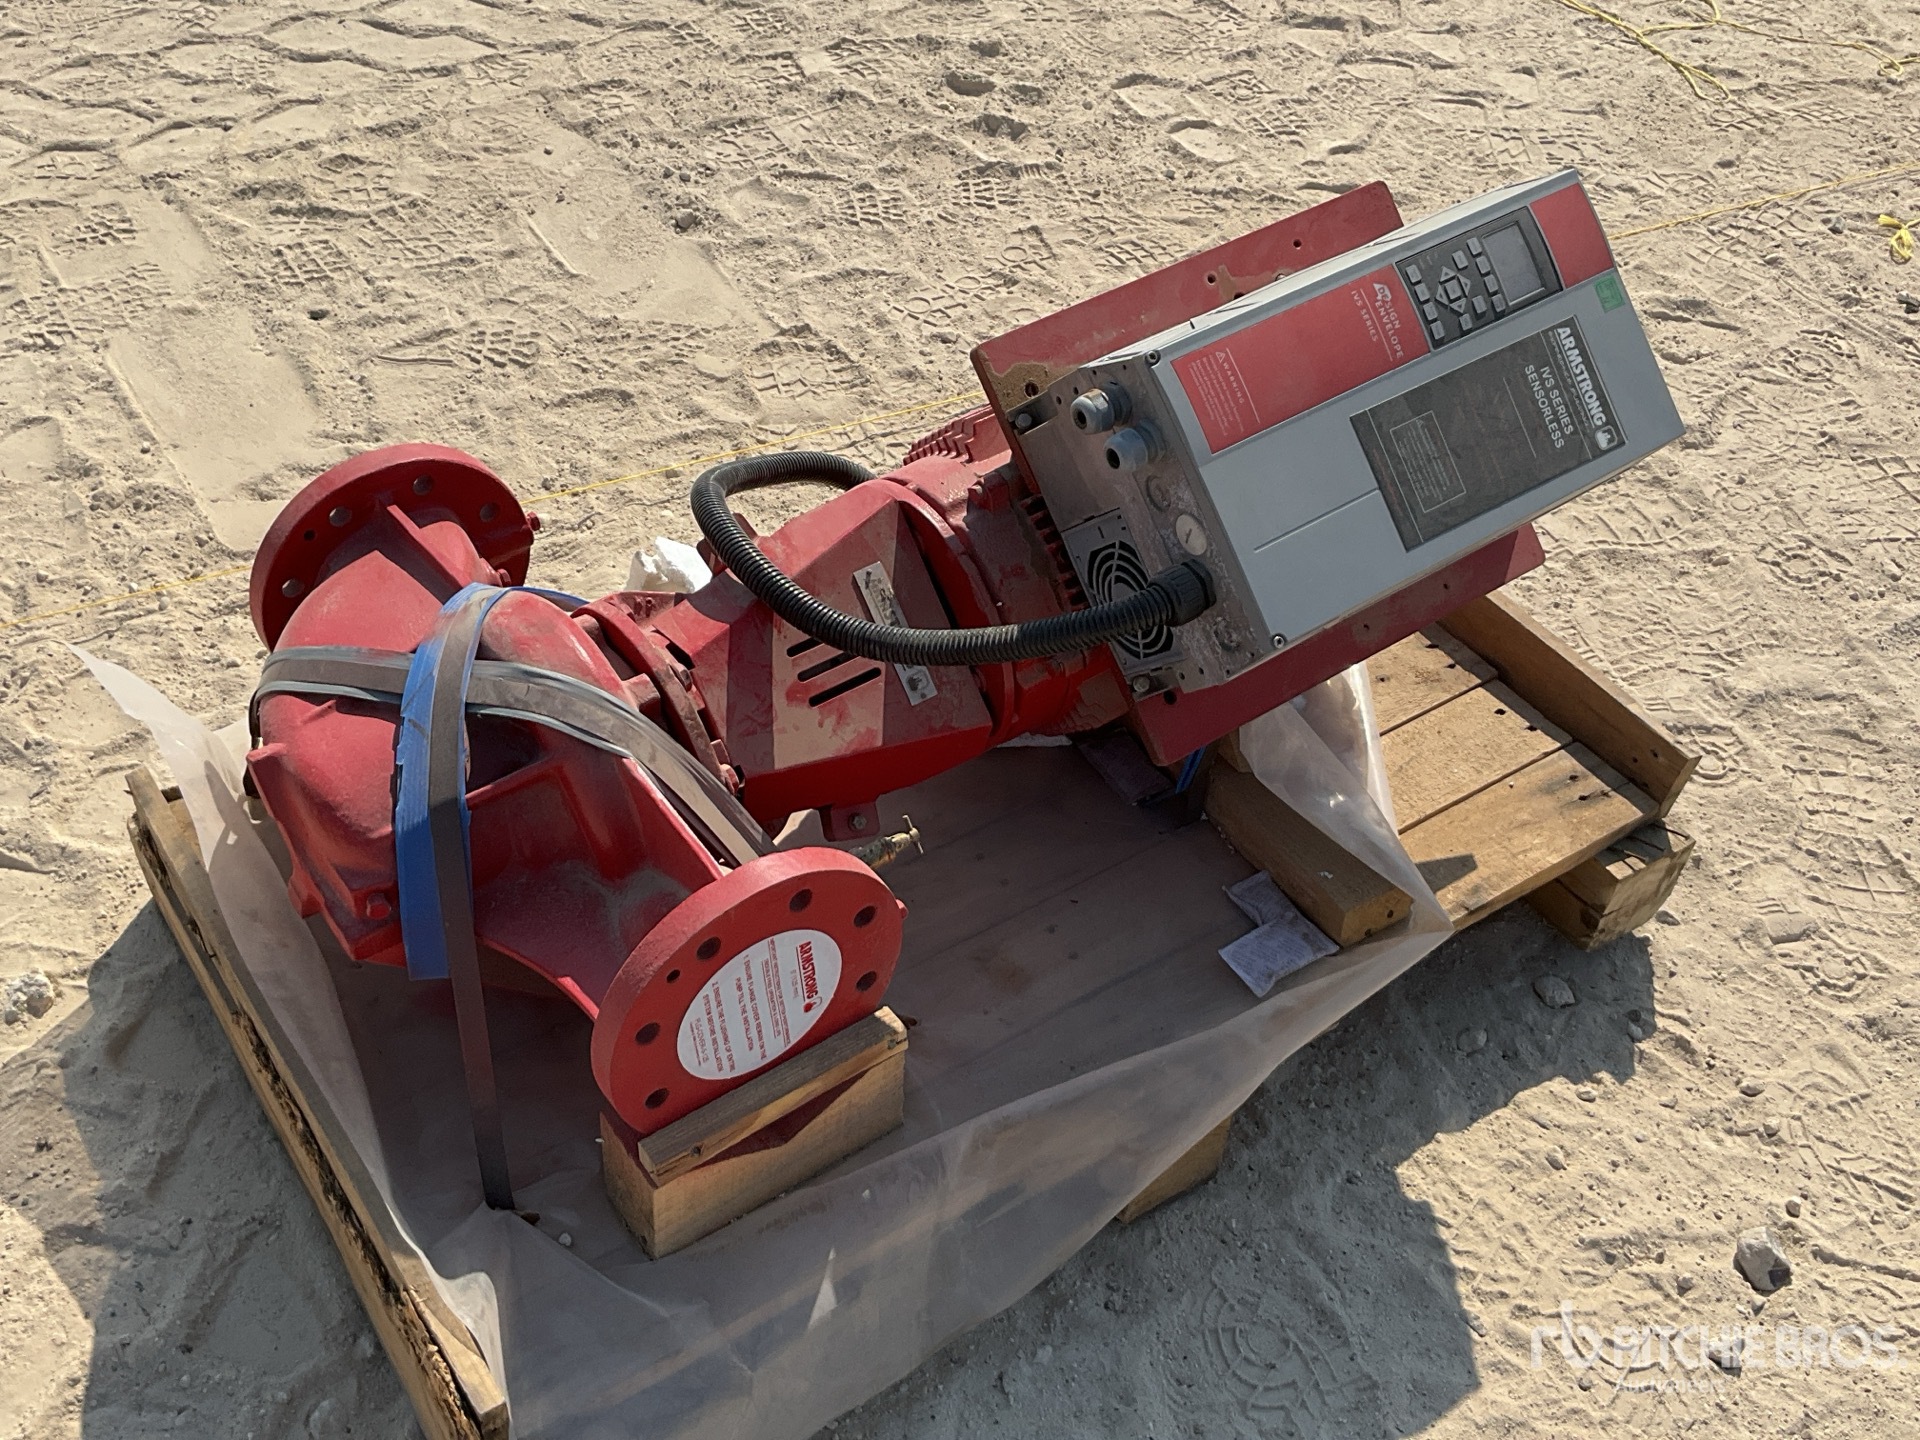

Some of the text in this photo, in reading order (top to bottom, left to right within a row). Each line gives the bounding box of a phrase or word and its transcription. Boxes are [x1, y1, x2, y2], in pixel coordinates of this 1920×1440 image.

[1351, 290, 1378, 342] IVS SERIES
[1375, 301, 1404, 359] ENVELOPE
[1223, 361, 1244, 404] WARNING
[1540, 366, 1574, 435] IVS SERIES
[1557, 326, 1606, 426] ARMSTRONG
[1525, 364, 1565, 449] SENSORLESS
[744, 960, 752, 981] ENSURE
[747, 981, 756, 1002] FLANGE
[799, 941, 818, 999] ARMSTRONG
[750, 1002, 760, 1021] COVER
[769, 988, 777, 1012] OPERATION
[703, 994, 723, 1072] SYSTEM BEFORE INSTALLATION
[713, 987, 722, 1007] ENSURE
[719, 1019, 730, 1045] FLUSHING
[727, 1053, 735, 1072] ENTIRE
[742, 1015, 753, 1051] INSTALLATION
[755, 1022, 763, 1041] REMAIN
